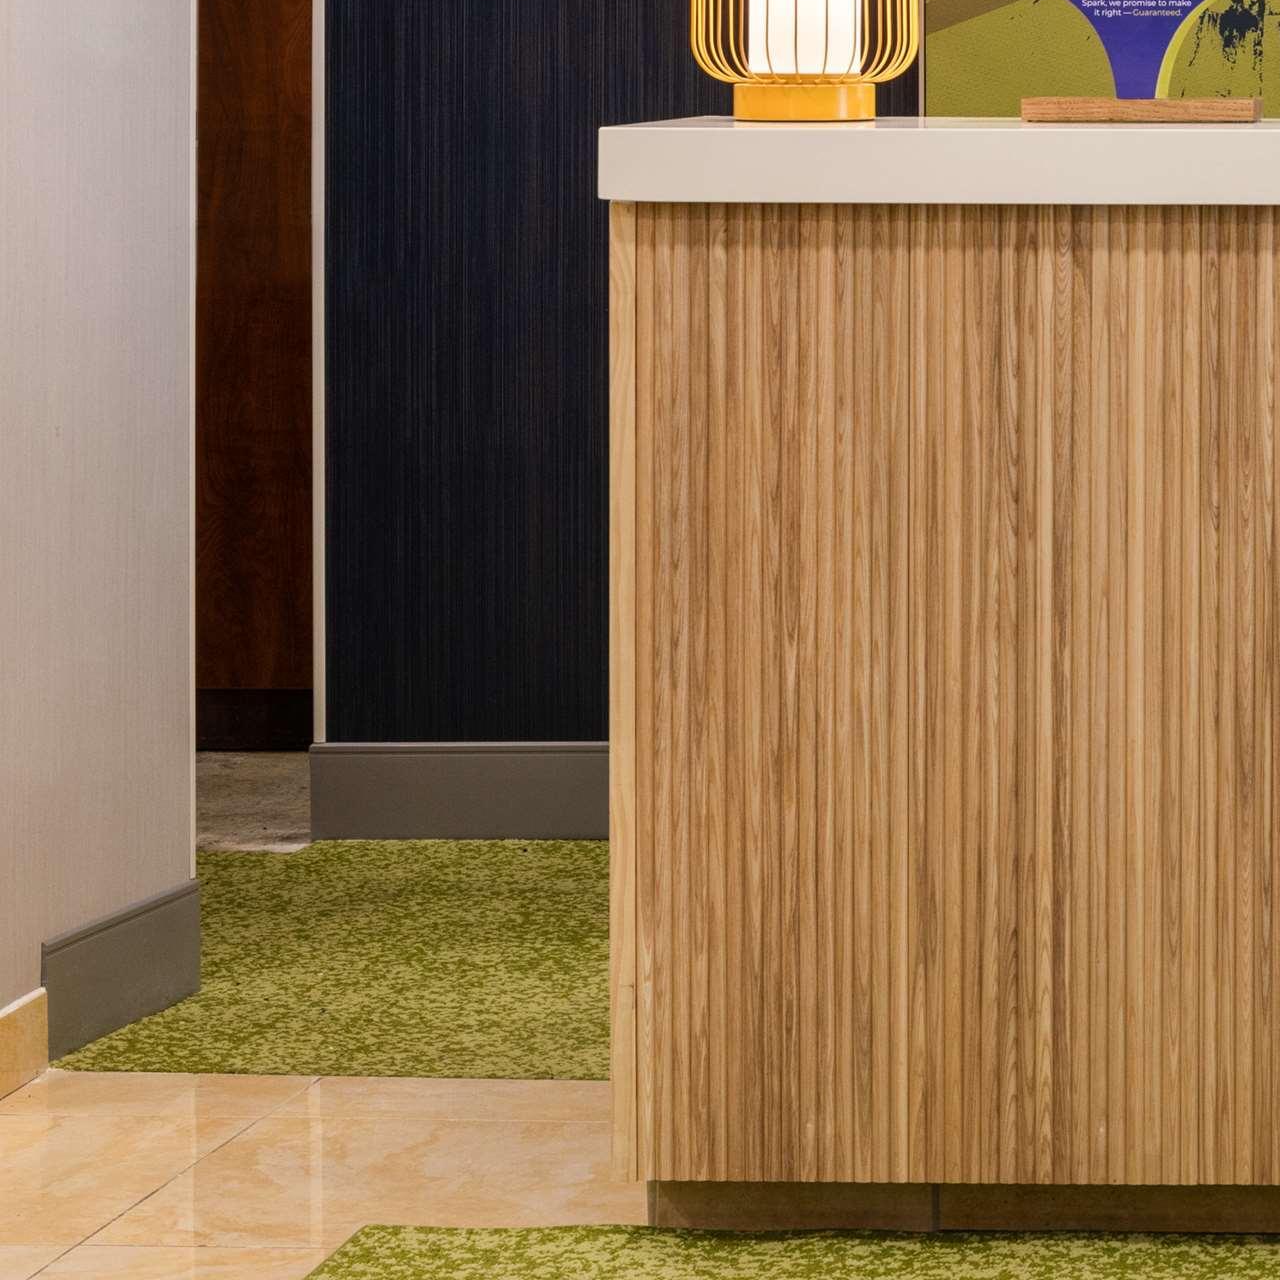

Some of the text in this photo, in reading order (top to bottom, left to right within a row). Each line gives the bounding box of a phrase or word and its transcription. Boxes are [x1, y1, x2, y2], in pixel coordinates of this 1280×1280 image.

[1081, 0, 1107, 8] Spark,
[1122, 0, 1157, 8] promise
[1168, 0, 1192, 7] make
[1101, 9, 1122, 18] right
[1132, 9, 1183, 17] Guaranteed.
